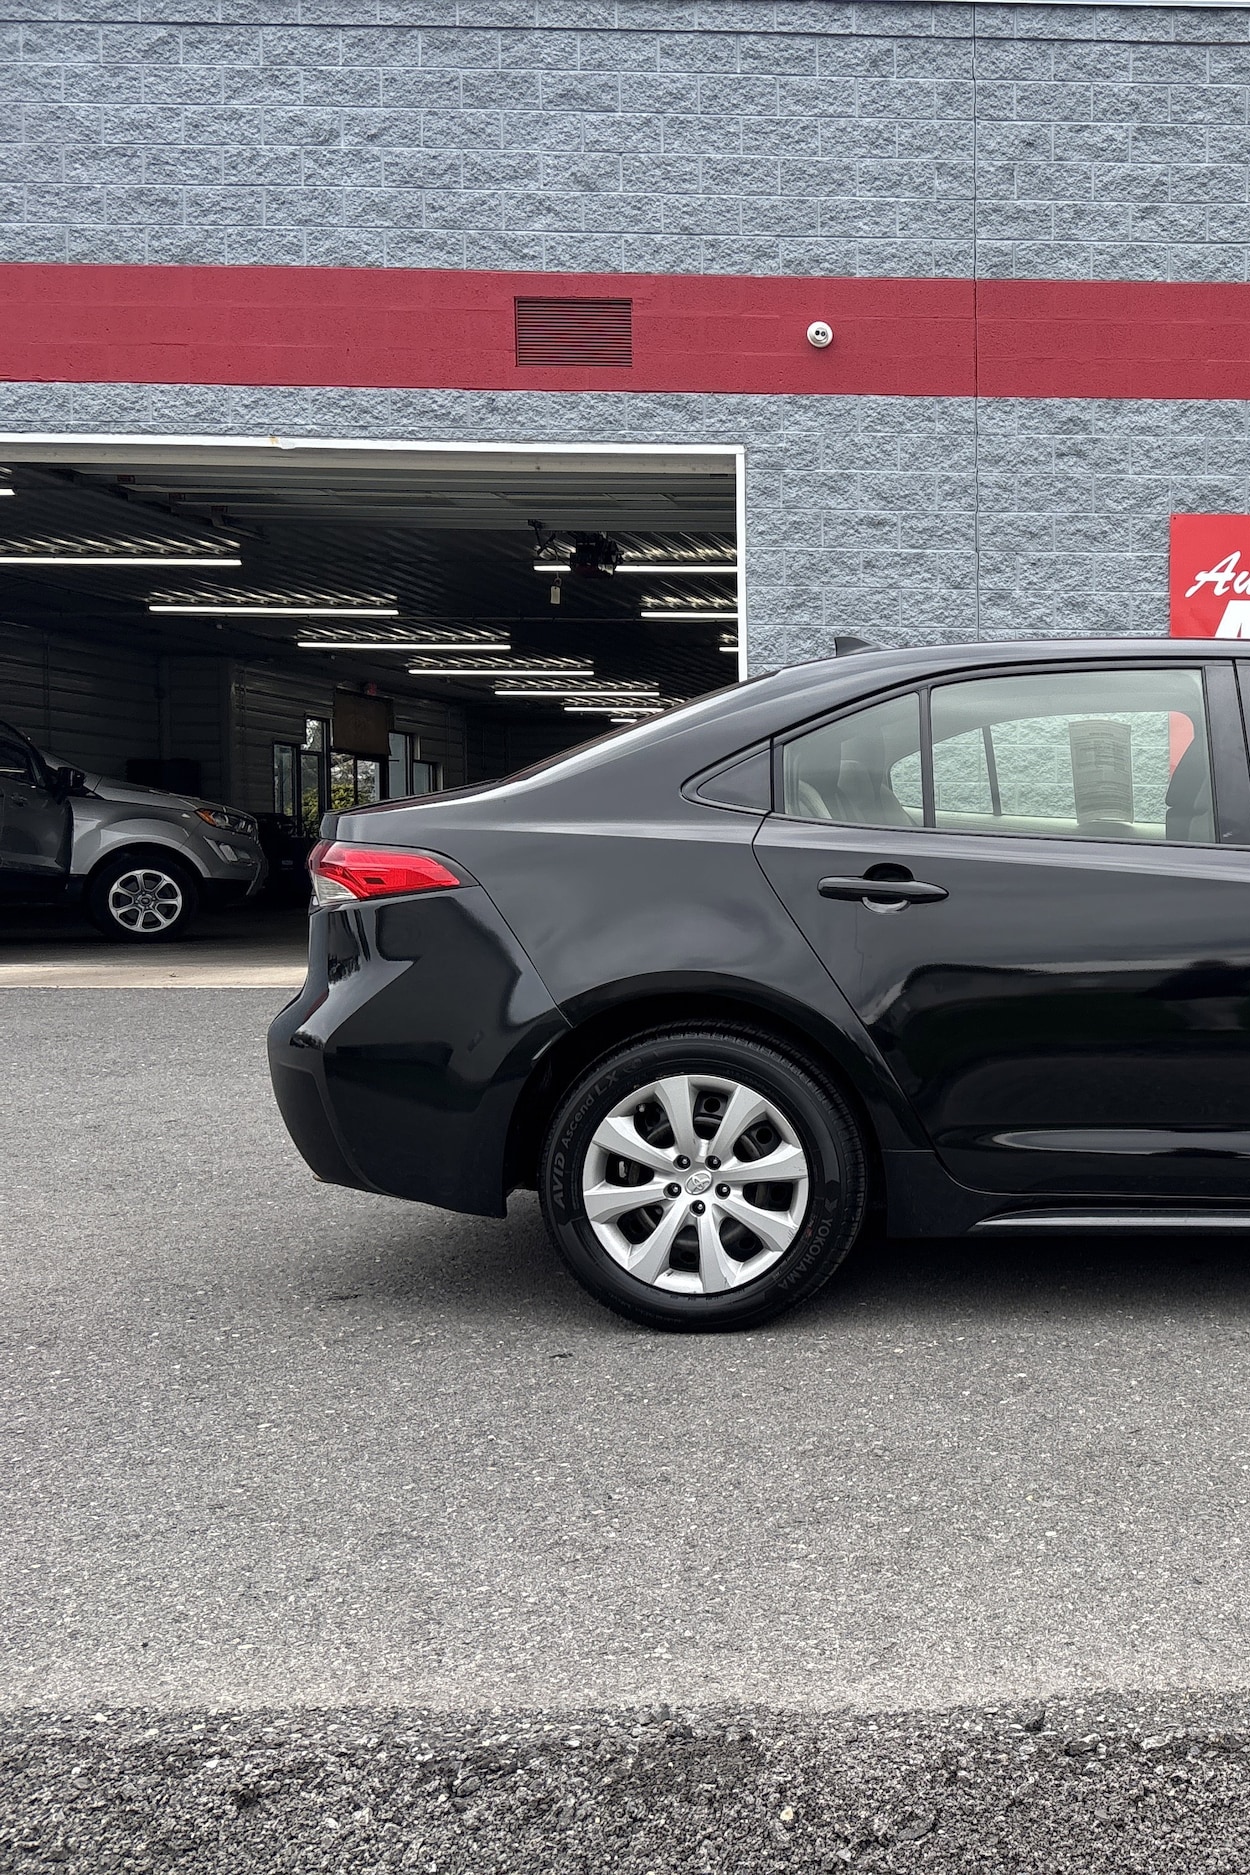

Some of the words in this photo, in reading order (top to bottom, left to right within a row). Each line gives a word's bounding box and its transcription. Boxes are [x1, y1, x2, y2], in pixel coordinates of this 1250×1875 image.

[552, 1151, 567, 1209] AVID
[561, 1094, 595, 1149] Ascend
[594, 1070, 620, 1098] LX
[778, 1217, 834, 1290] YOKOHAMA
